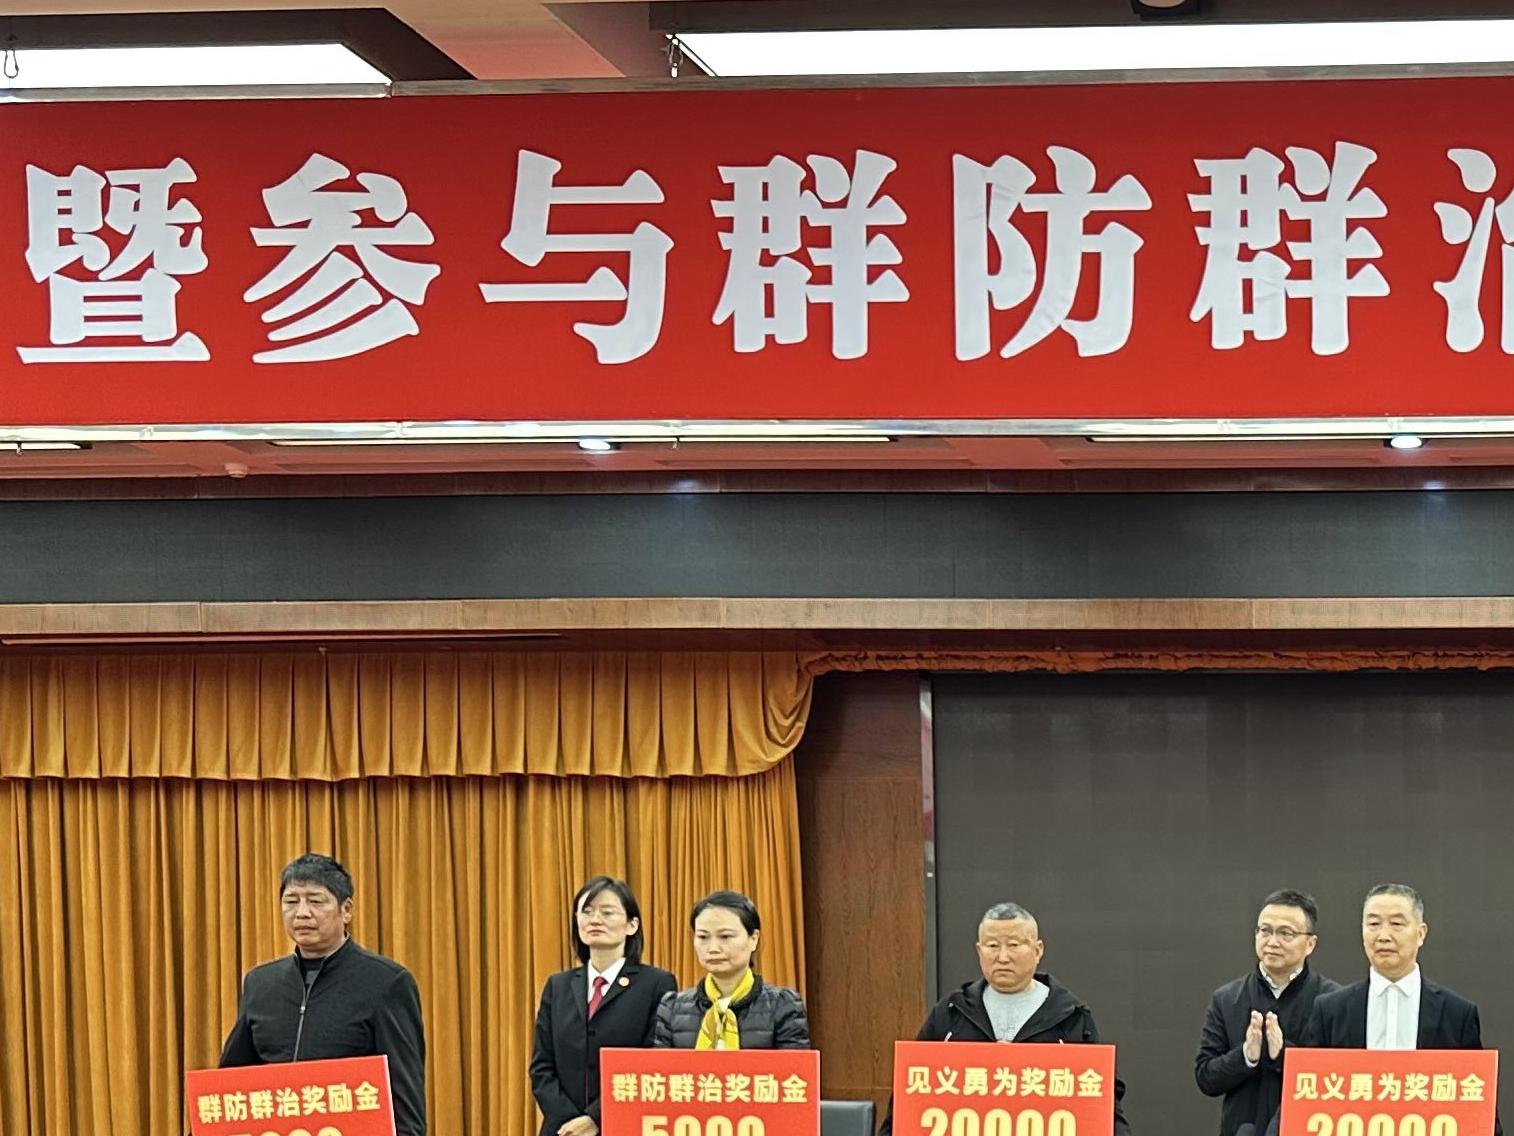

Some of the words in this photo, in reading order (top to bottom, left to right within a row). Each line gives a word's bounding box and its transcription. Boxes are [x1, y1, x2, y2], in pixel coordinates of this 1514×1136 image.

[612, 1073, 807, 1102] 群防群治奖励金
[905, 1067, 1103, 1097] 见义勇为奖励金
[1293, 1072, 1485, 1102] 见义勇为奖励金
[198, 1082, 379, 1123] 群防群治奖励金
